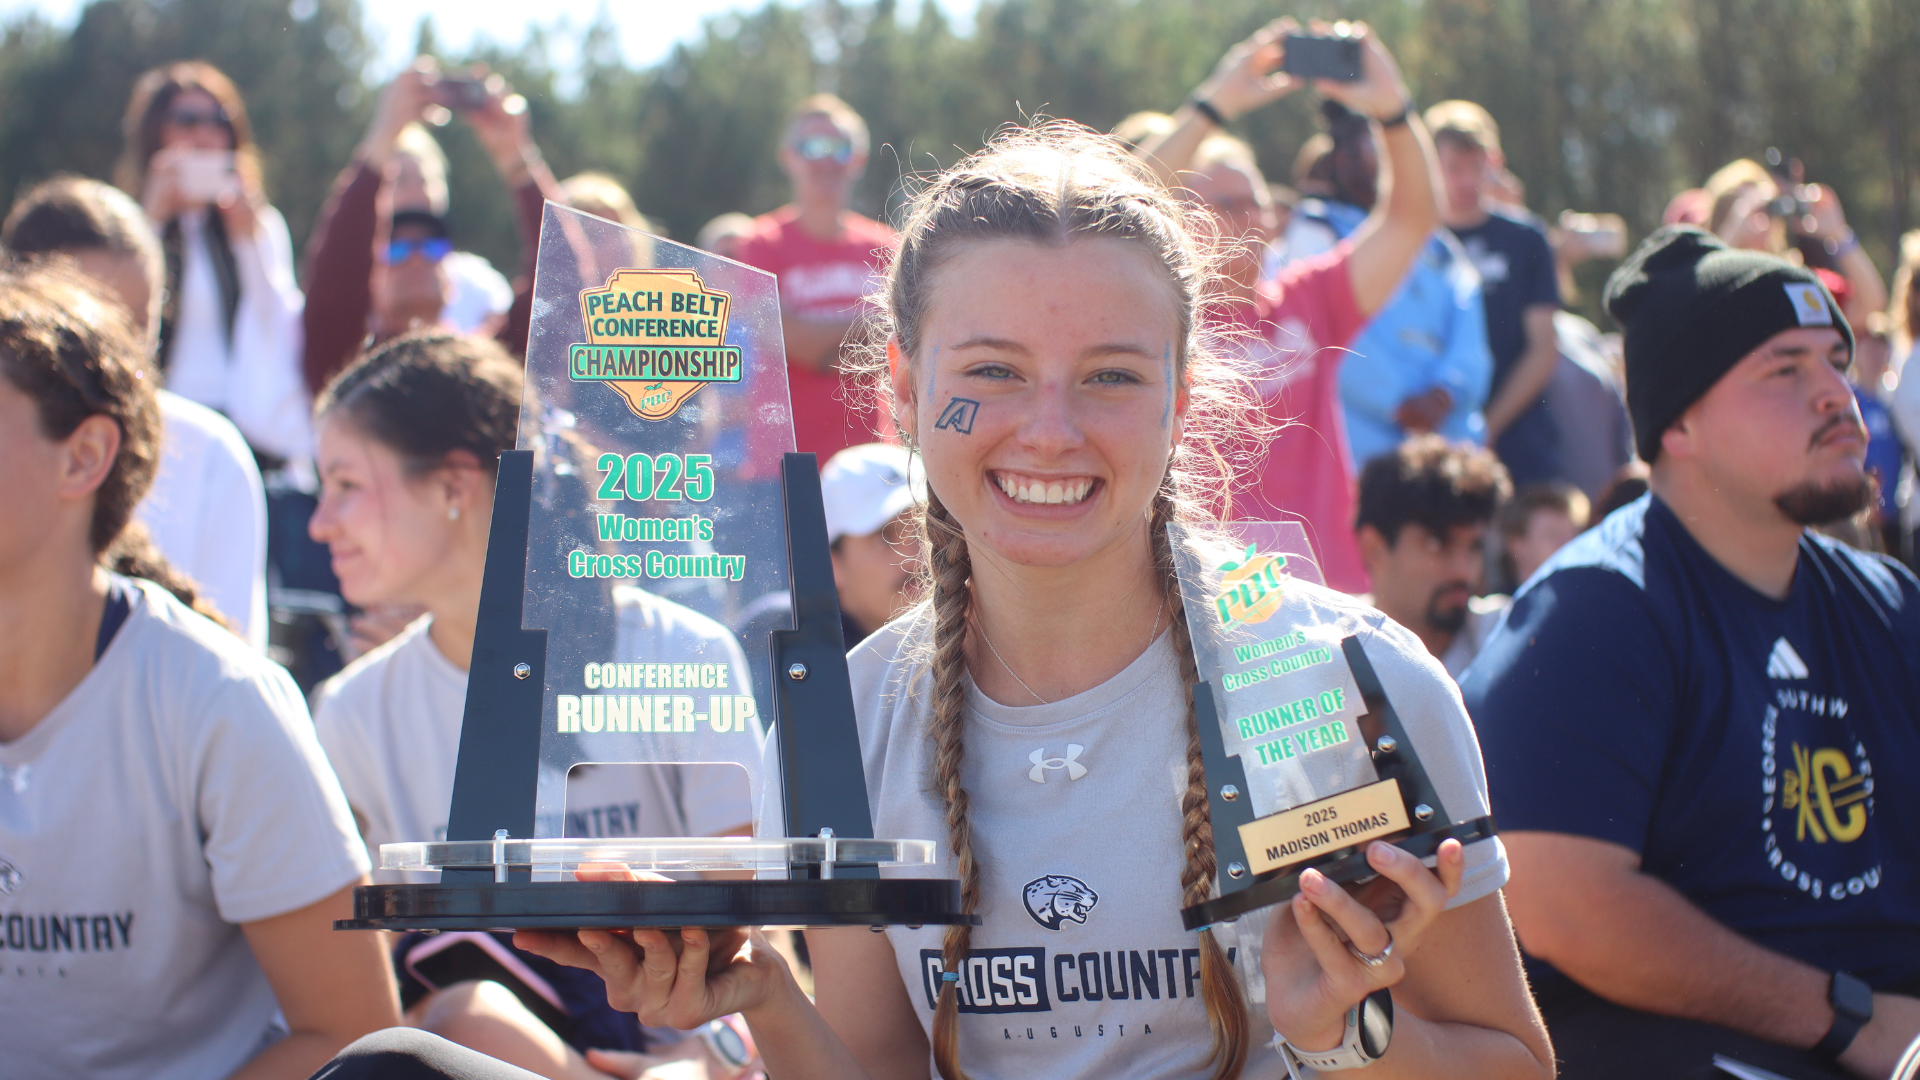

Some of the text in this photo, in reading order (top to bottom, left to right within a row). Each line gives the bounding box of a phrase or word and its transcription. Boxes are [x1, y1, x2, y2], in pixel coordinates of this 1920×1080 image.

[588, 291, 724, 317] PEACH BELT
[593, 318, 718, 338] CONFERENCE
[573, 349, 738, 378] CHAMPIONSHIP
[639, 390, 672, 411] PBC
[934, 396, 980, 435] A
[596, 452, 714, 502] 2025
[597, 514, 714, 541] Women's
[568, 550, 746, 581] Cross Country
[1215, 555, 1290, 626] PBC
[1233, 630, 1307, 664] Women's
[584, 662, 729, 690] CONFERENCE
[1222, 646, 1333, 692] Cross Country
[557, 694, 756, 734] RUNNER-UP
[1236, 687, 1346, 741] RUNNER OF
[1254, 720, 1350, 767] THE YEAR
[1303, 806, 1338, 827] 2025
[1265, 812, 1389, 861] MADISON THOMAS
[0, 912, 134, 952] OUNTRY
[1054, 947, 1237, 1002] COUNTR
